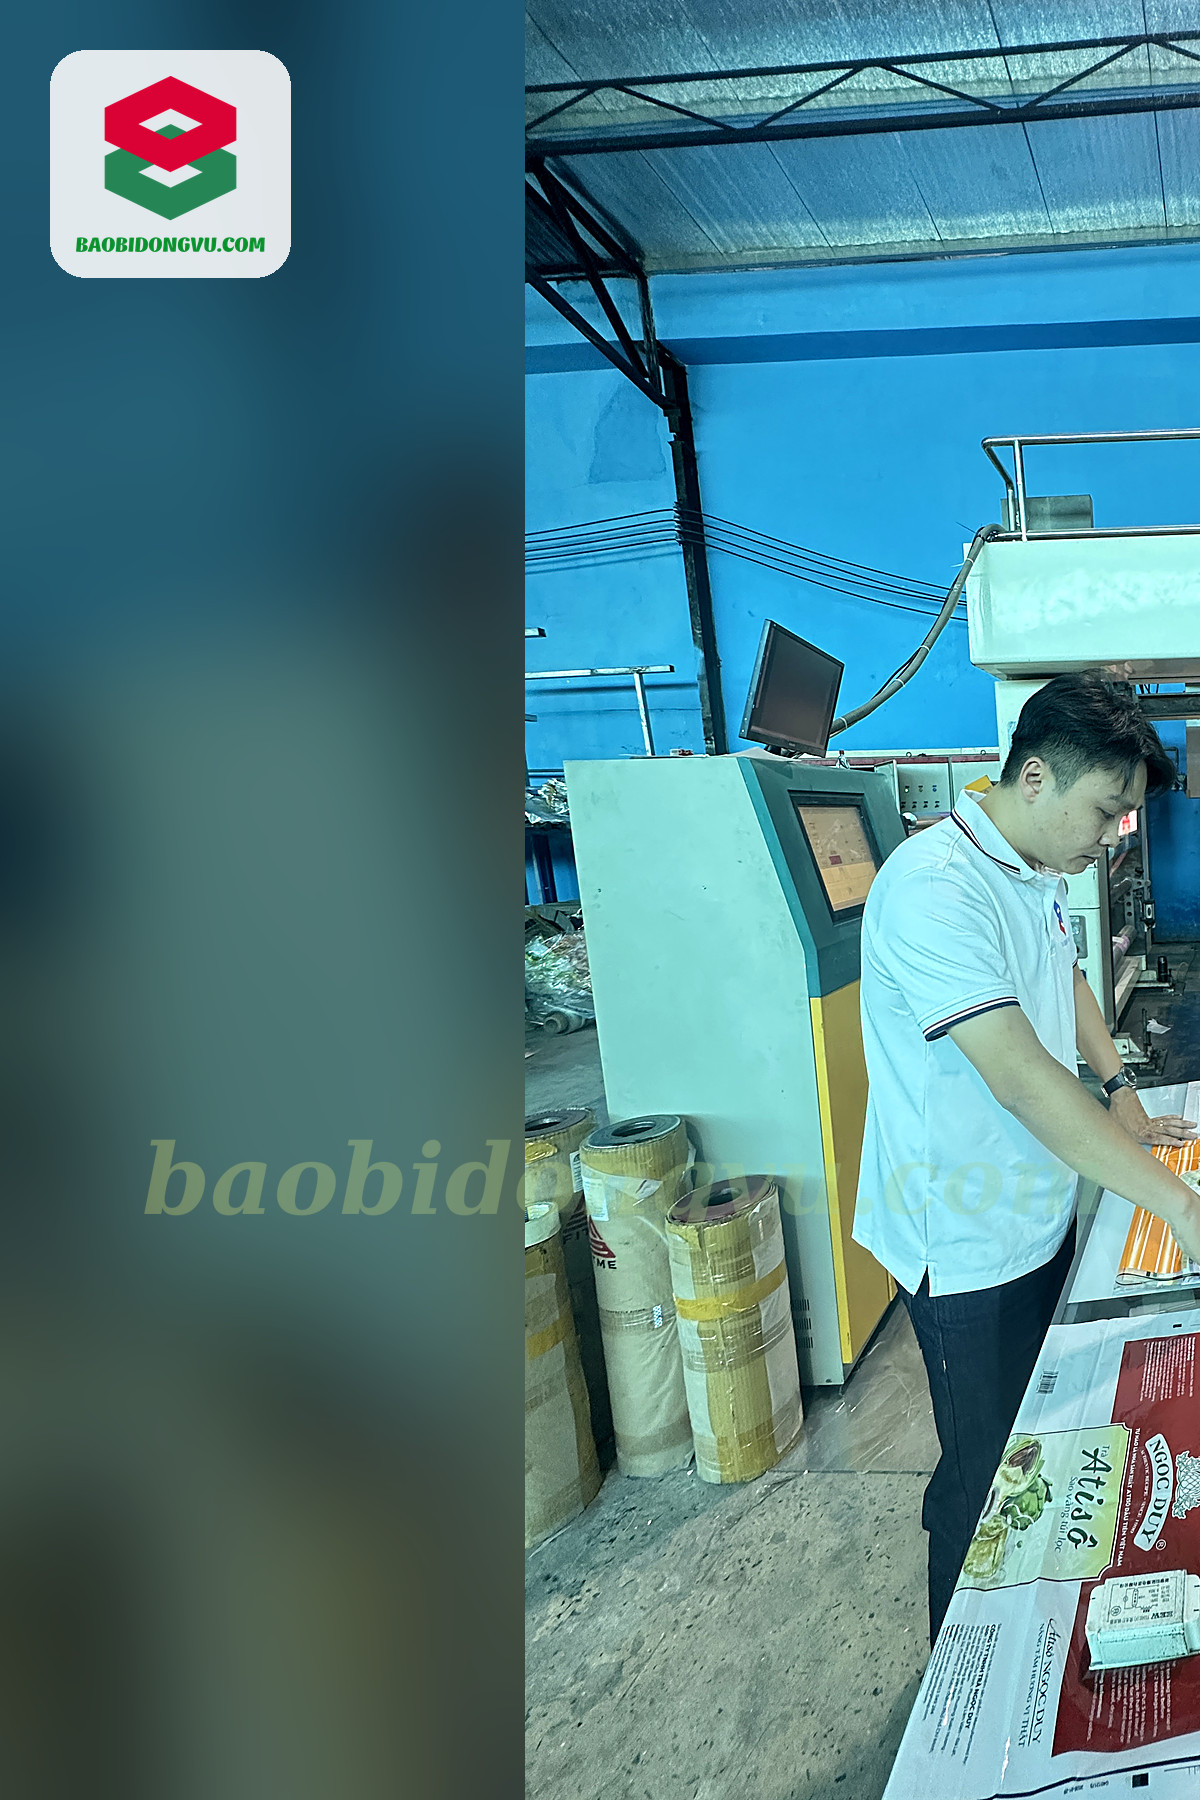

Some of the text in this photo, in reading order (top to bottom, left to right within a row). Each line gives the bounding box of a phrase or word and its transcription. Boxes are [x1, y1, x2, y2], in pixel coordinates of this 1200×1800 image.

[1100, 1444, 1109, 1458] Trà
[1068, 1446, 1113, 1552] Atisô
[1140, 1439, 1169, 1542] NGOC DUY
[1053, 1476, 1077, 1553] Sao vàng túi lọc
[986, 1623, 997, 1644] CÔNG
[984, 1643, 991, 1652] TY
[979, 1652, 988, 1673] TNHH
[964, 1711, 973, 1729] DUY
[1031, 1707, 1044, 1743] DUY
